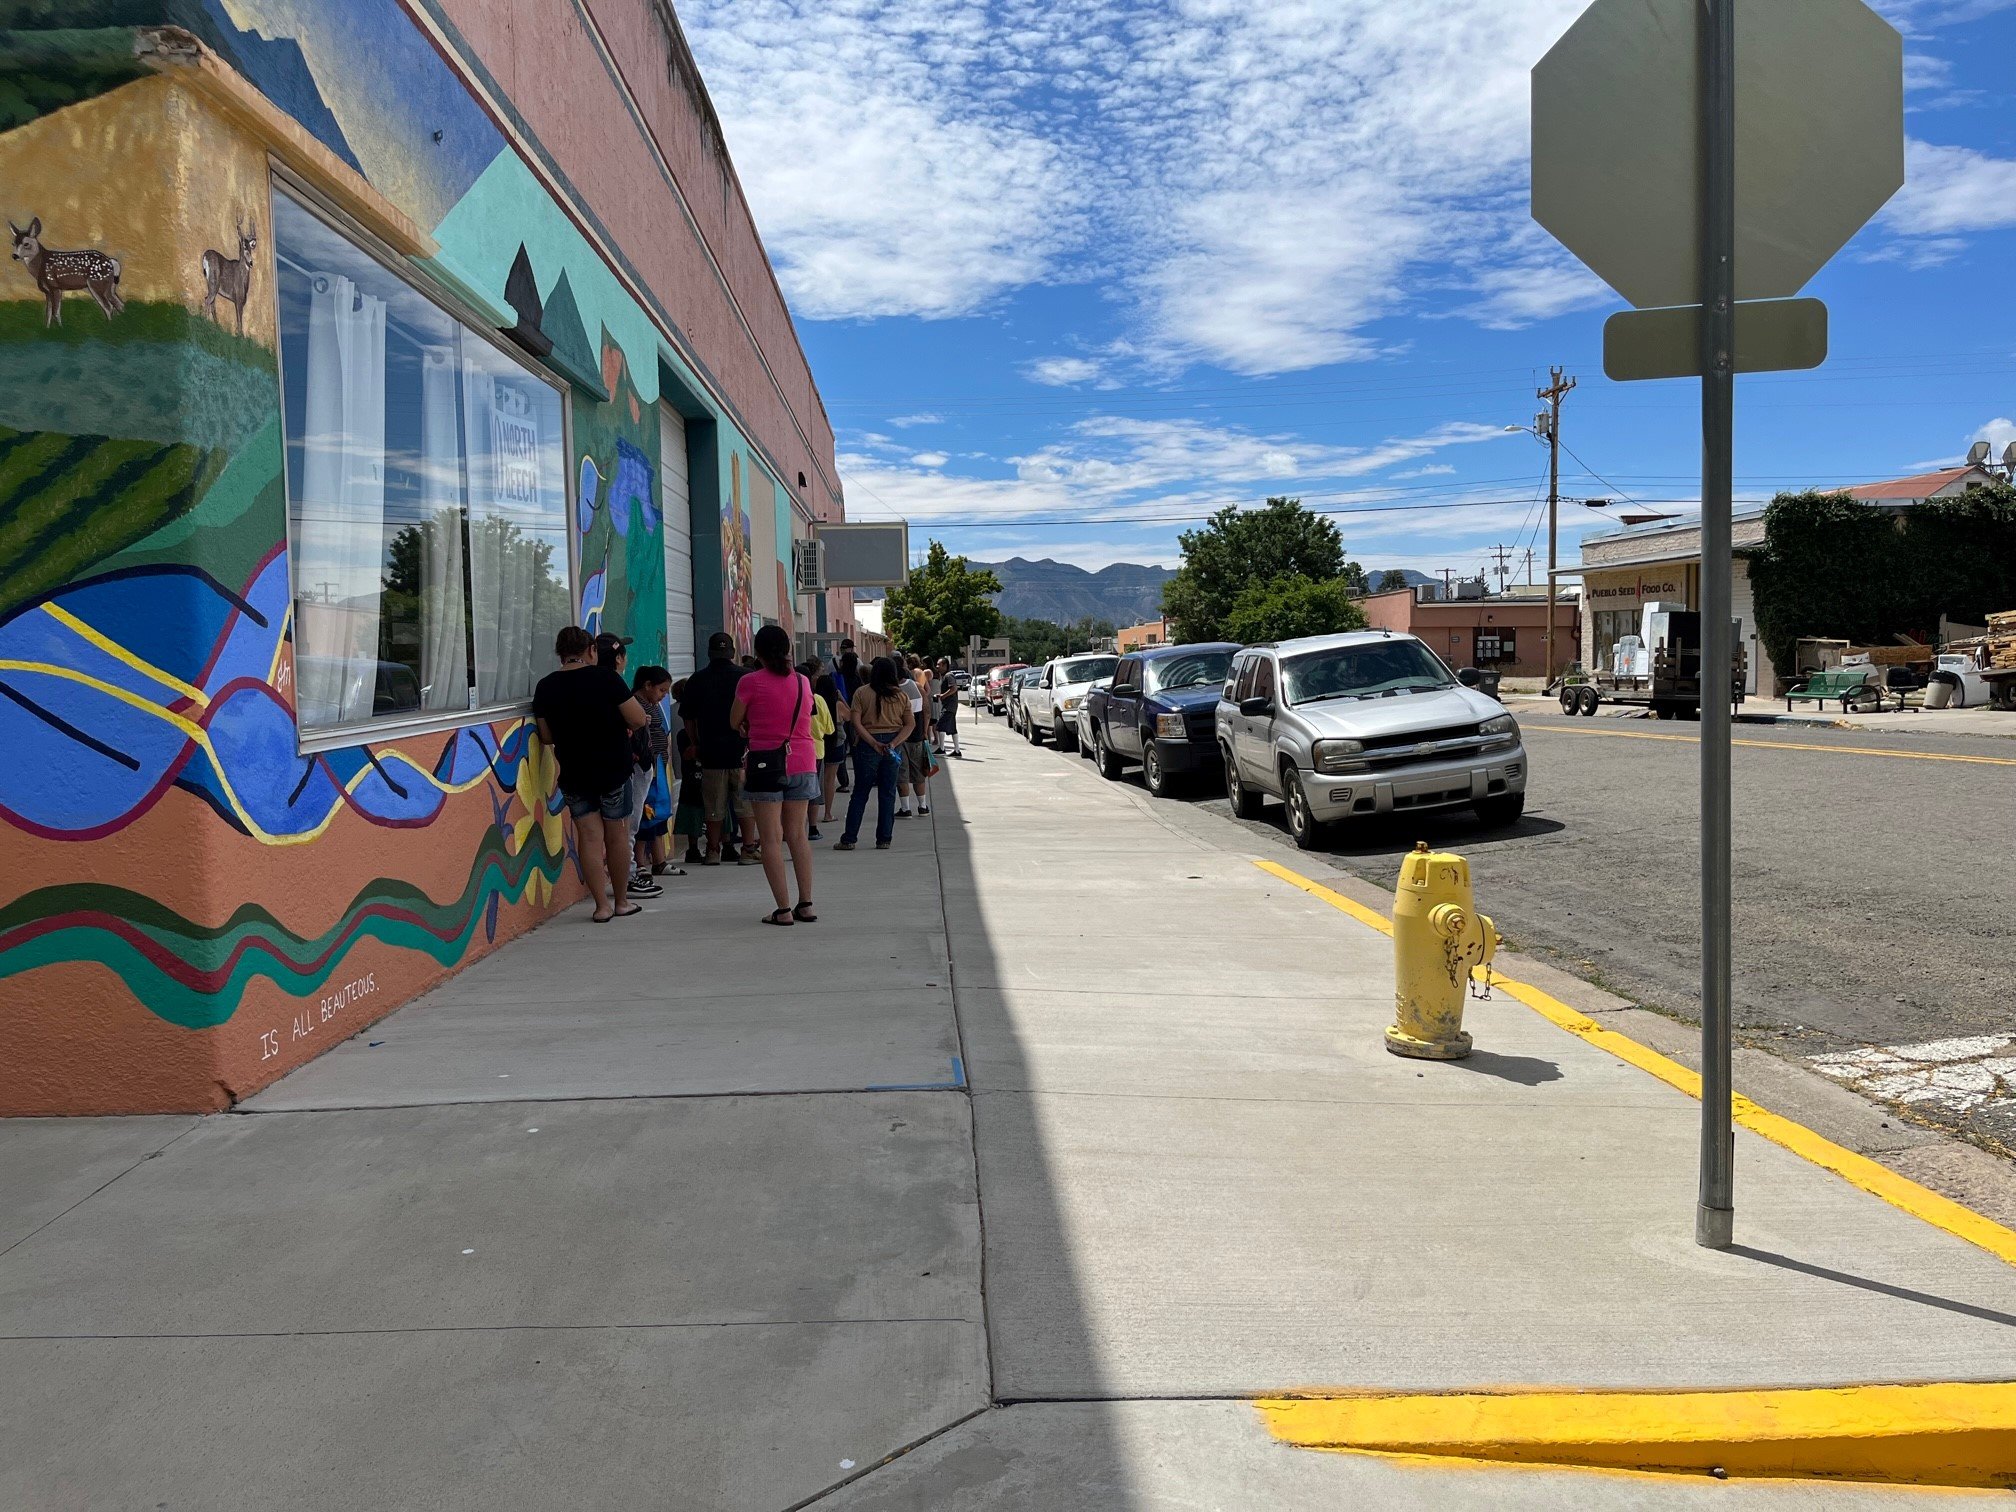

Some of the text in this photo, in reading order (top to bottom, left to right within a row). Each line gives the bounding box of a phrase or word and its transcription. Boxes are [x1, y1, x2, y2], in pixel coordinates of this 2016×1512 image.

[502, 420, 537, 462] NORTH
[505, 463, 538, 503] BEECH
[1592, 588, 1617, 598] PUEBLO
[1618, 586, 1636, 596] SEED
[1641, 584, 1661, 594] FOOD
[260, 972, 380, 1060] IS ALL BEAUTEOUS.
